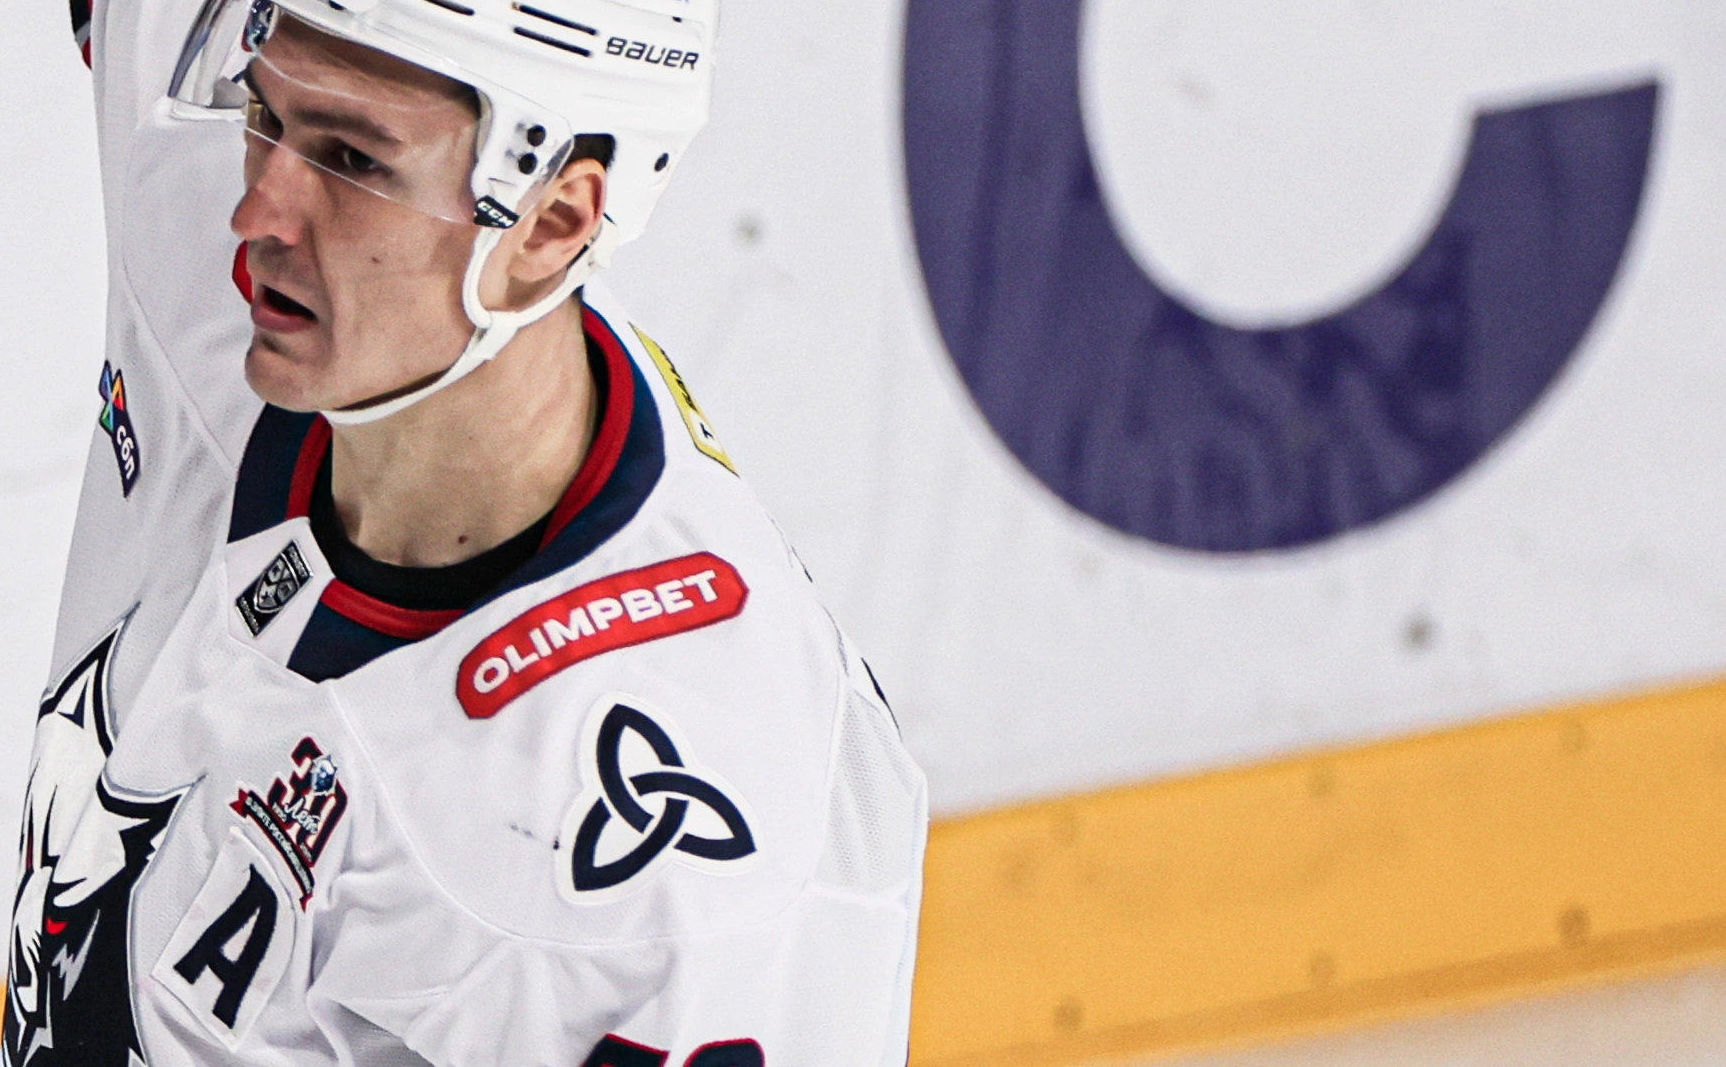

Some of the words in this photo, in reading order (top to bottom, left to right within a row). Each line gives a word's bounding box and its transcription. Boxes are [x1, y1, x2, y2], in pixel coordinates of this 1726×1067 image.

[477, 201, 515, 227] CCM
[116, 425, 135, 479] сбп
[472, 569, 717, 694] OLIMPBET
